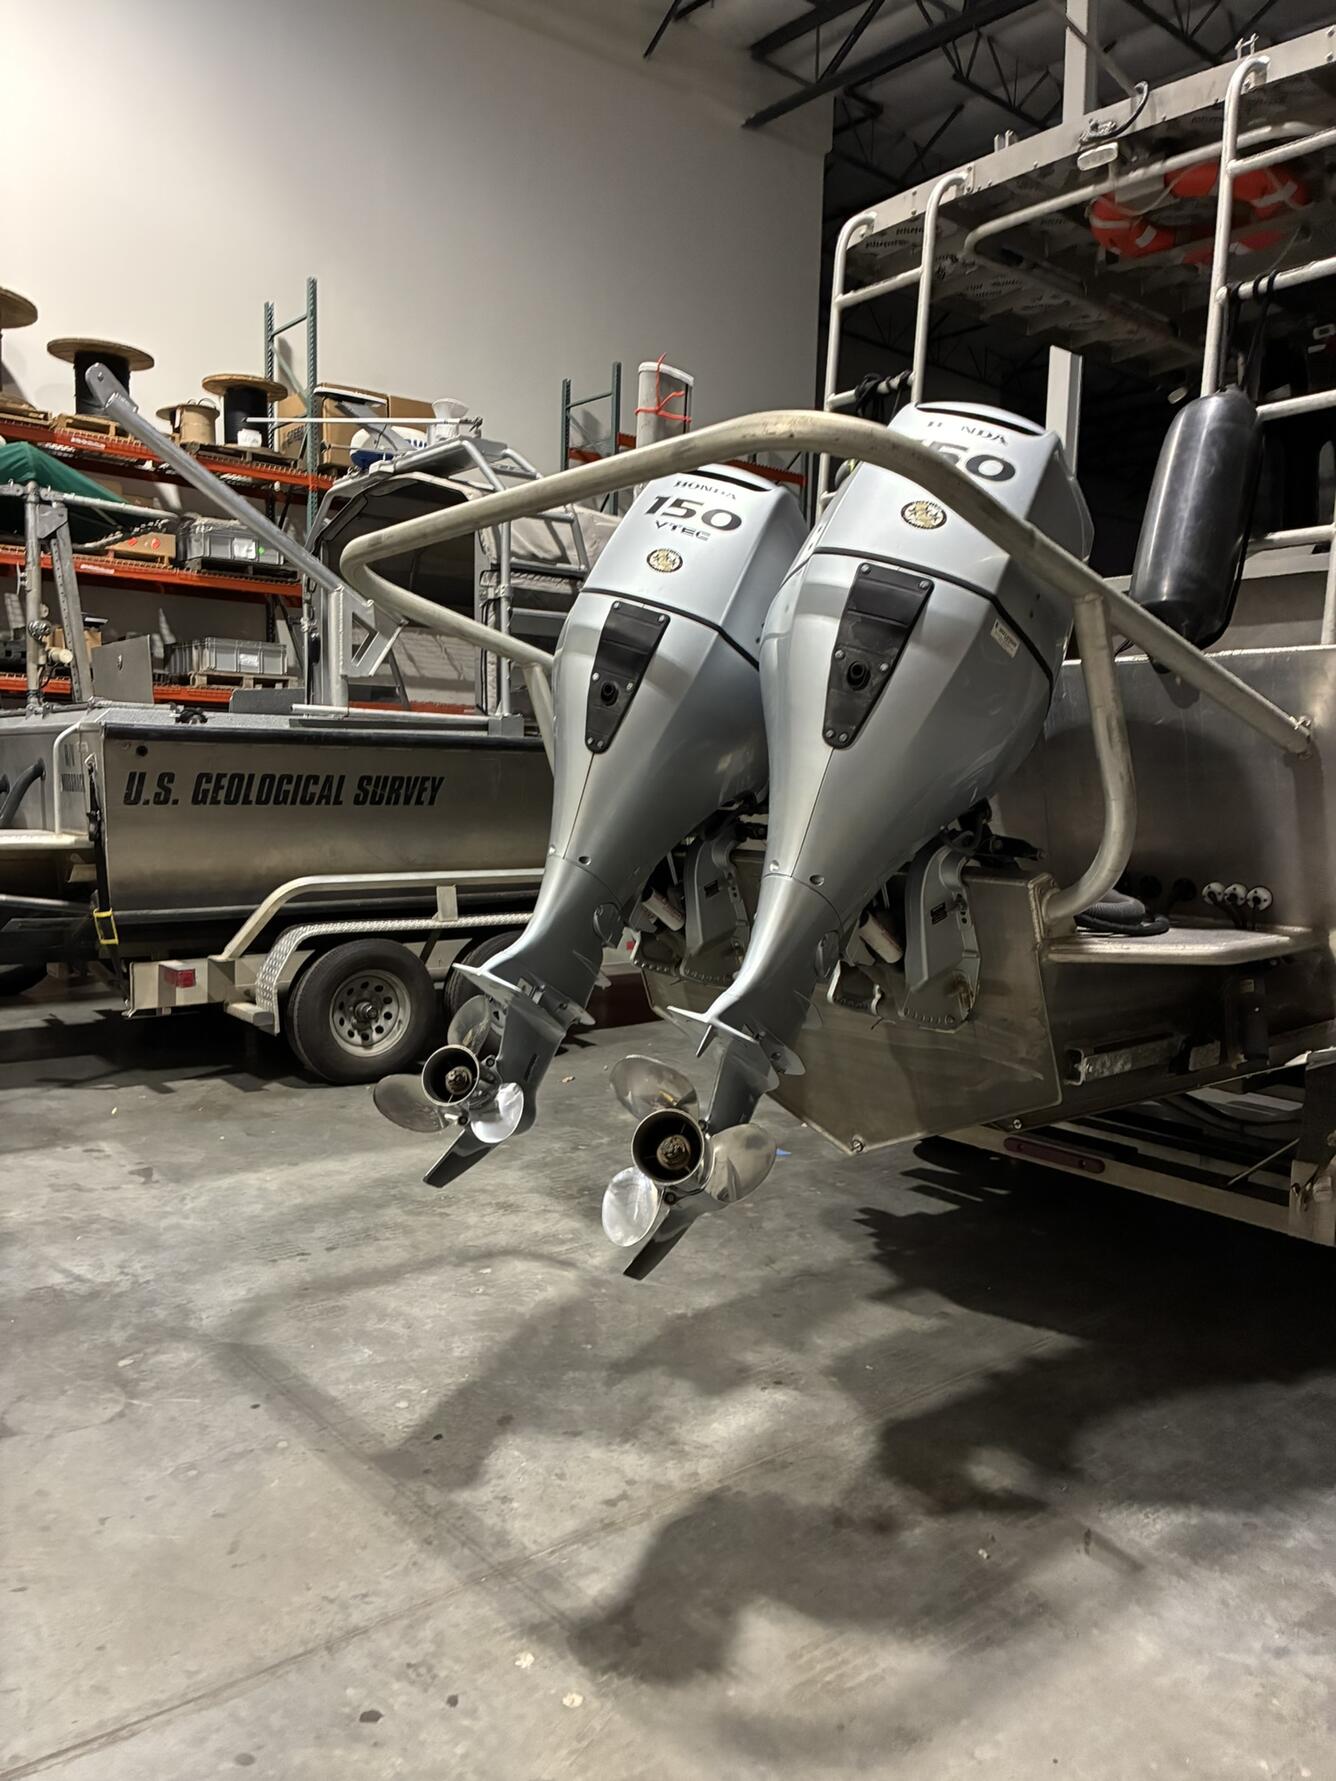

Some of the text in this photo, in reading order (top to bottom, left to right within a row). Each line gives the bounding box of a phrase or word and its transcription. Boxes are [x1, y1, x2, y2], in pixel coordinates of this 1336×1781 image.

[644, 495, 742, 532] 150
[655, 520, 711, 541] VTEC
[123, 771, 445, 806] U.S. GEOLOGICAL SURVEY
